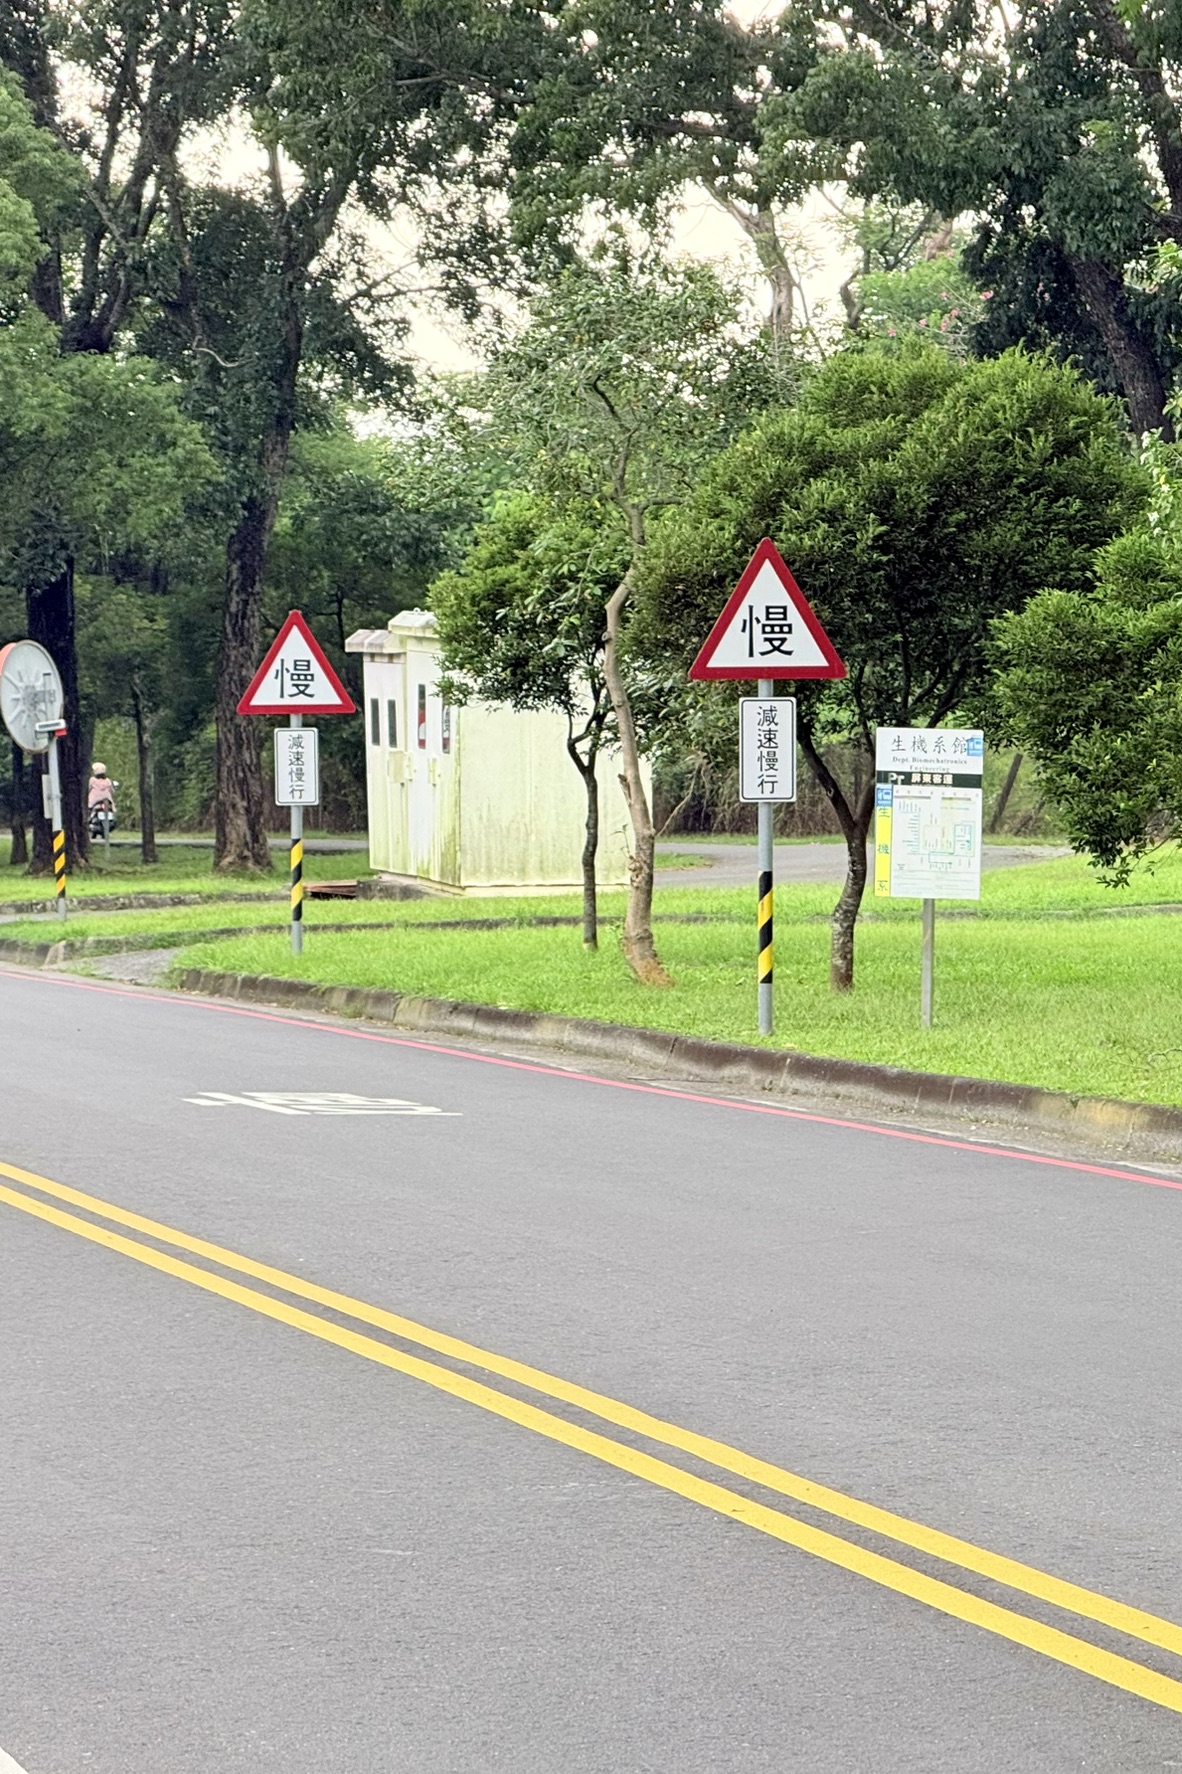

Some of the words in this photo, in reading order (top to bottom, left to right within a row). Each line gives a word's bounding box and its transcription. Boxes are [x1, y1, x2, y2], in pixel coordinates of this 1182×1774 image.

[740, 604, 794, 658] 慢
[274, 658, 315, 699] 慢
[288, 734, 305, 800] 減速慢行
[757, 705, 779, 795] 減速慢行
